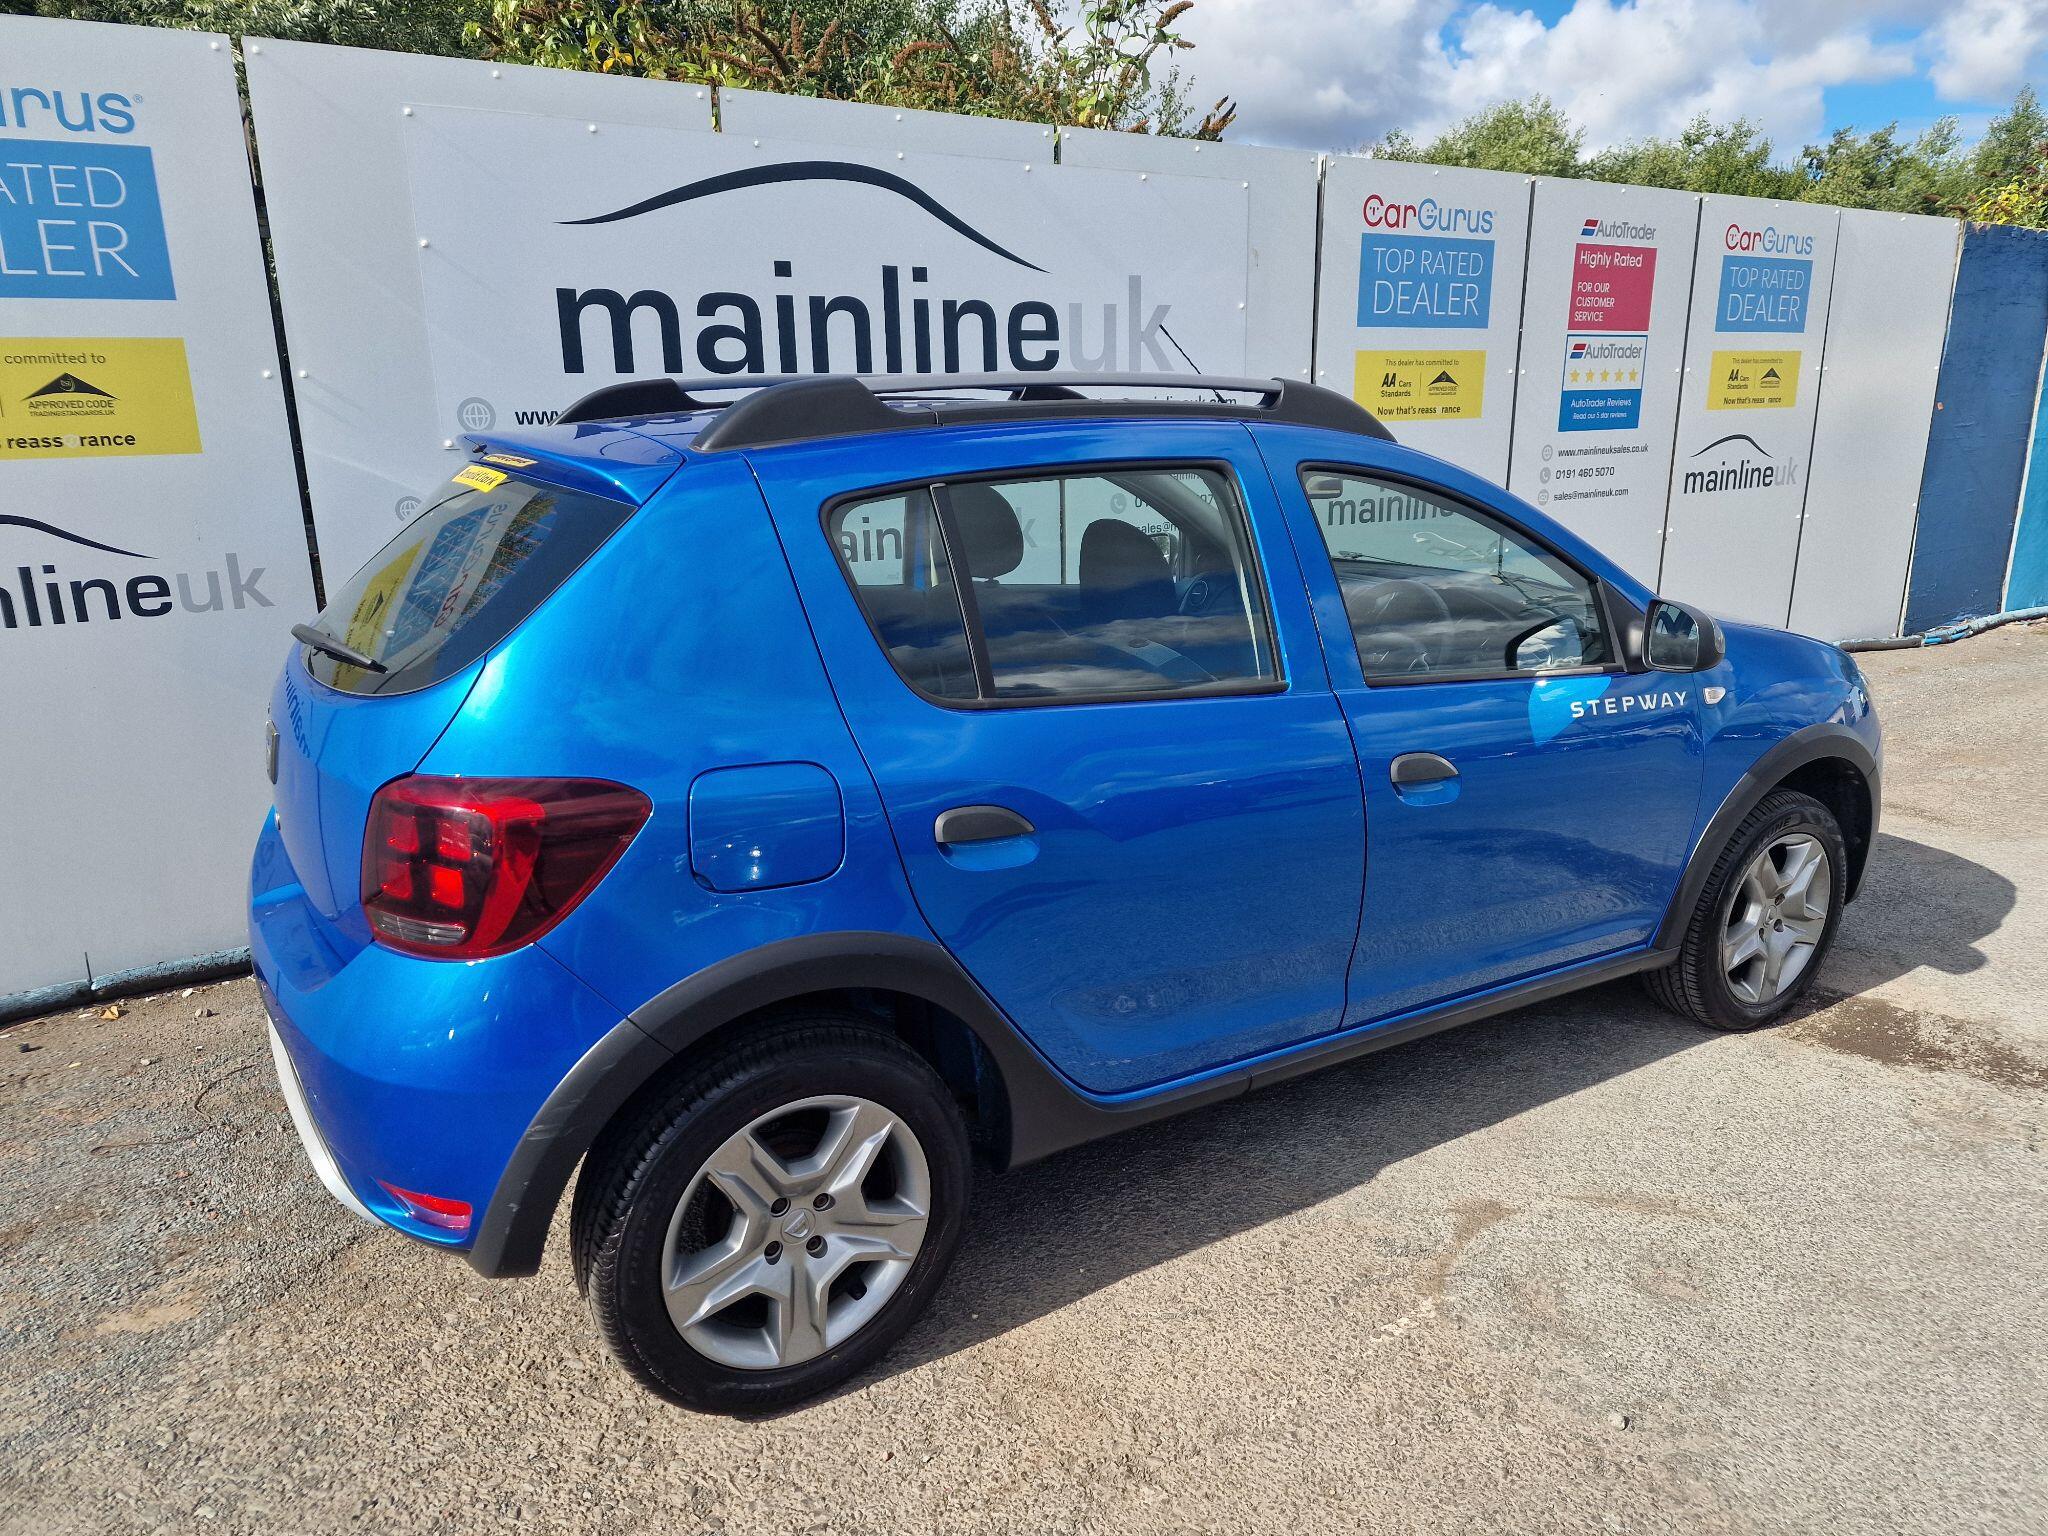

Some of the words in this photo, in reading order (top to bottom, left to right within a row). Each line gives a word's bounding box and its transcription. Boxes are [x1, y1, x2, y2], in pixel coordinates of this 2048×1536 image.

[1363, 194, 1493, 234] CarGurus
[1596, 220, 1657, 240] AutoTrader
[1725, 223, 1814, 256] CarGurus
[1373, 247, 1415, 274] TOP
[1420, 250, 1484, 277] RATED
[1580, 251, 1612, 269] Highly
[1614, 252, 1643, 267] Rated
[1730, 266, 1759, 288] TOP
[1761, 268, 1805, 290] RATED
[1577, 282, 1592, 293] FOR
[1594, 283, 1610, 293] OUR
[1373, 280, 1480, 316] DEALER
[1576, 297, 1615, 308] CUSTOMER
[1574, 311, 1604, 322] SERVICE
[1727, 294, 1800, 322] DEALER
[4, 353, 87, 364] committed
[91, 353, 106, 364] to
[1584, 343, 1643, 360] AutoTrader
[1381, 372, 1397, 388] AA
[1398, 380, 1412, 388] Cars
[1380, 390, 1411, 398] Standards
[1571, 398, 1606, 408] AutoTrader
[1607, 397, 1632, 407] Reviews
[28, 400, 84, 410] APPROVED
[85, 400, 115, 409] CODE
[1377, 406, 1394, 416] Now
[1396, 405, 1416, 415] that's
[1556, 469, 1576, 479] 0191
[1578, 468, 1594, 478] 460
[1595, 466, 1615, 477] 5070
[1683, 457, 1799, 494] mainlineuk
[1570, 691, 1687, 718] STEPWAY
